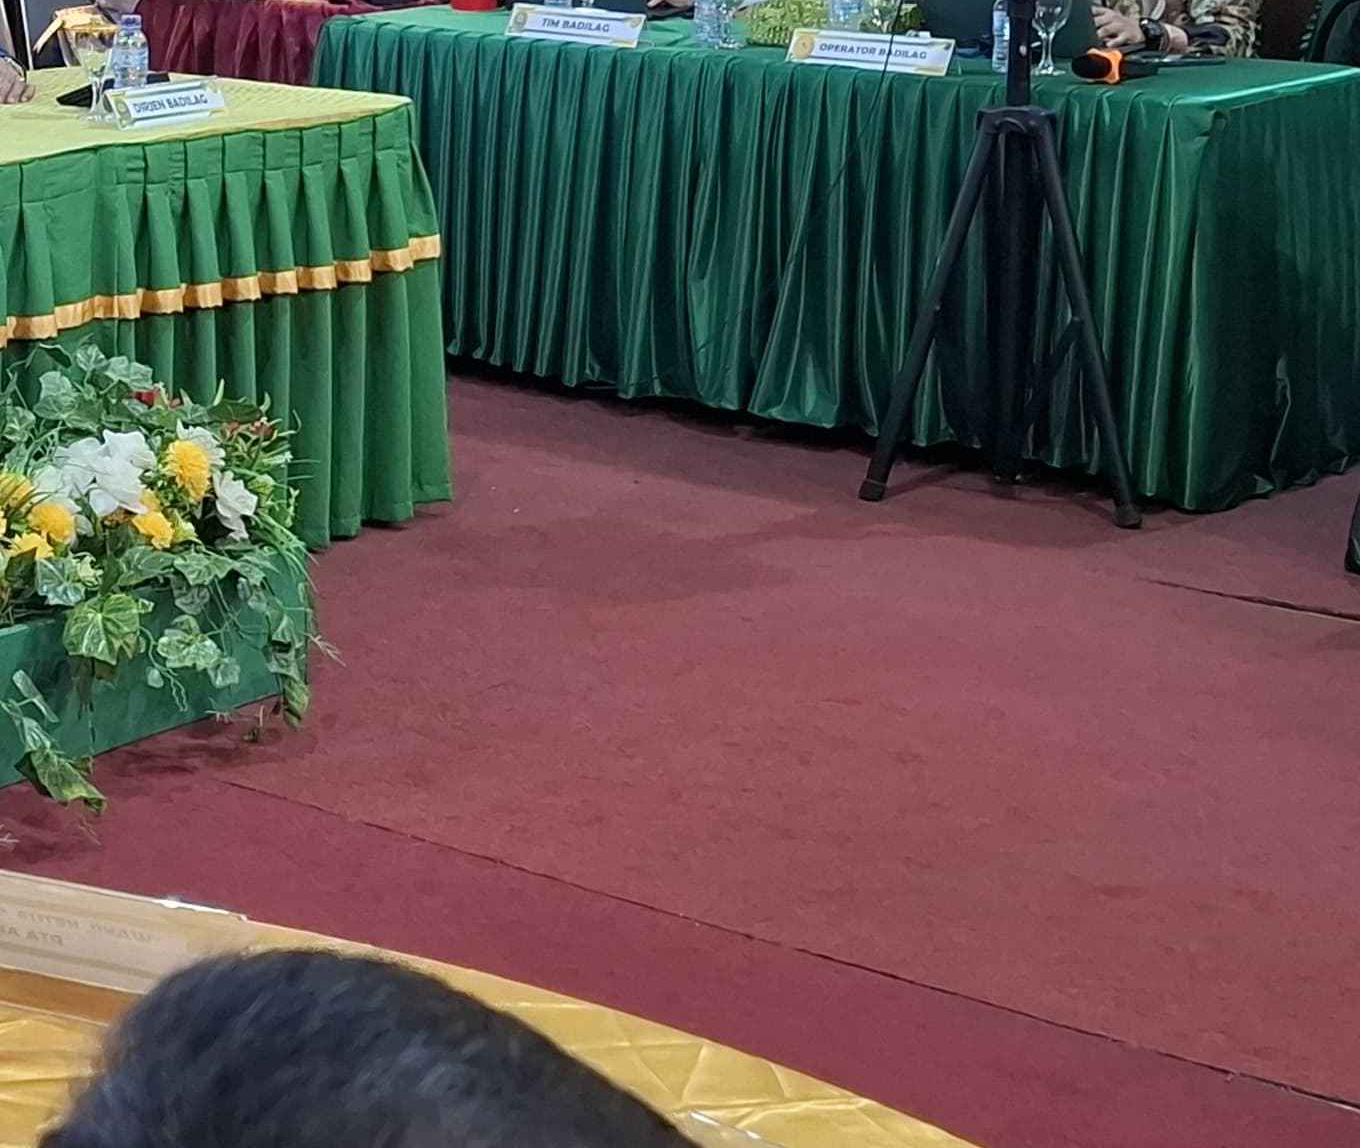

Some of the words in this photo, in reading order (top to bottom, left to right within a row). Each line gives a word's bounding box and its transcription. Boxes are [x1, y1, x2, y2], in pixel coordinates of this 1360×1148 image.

[542, 18, 560, 28] TIM
[562, 20, 610, 33] BADILAG
[819, 42, 877, 56] OPERATOR
[132, 99, 167, 113] DIRJEN
[166, 93, 208, 109] BADILAG
